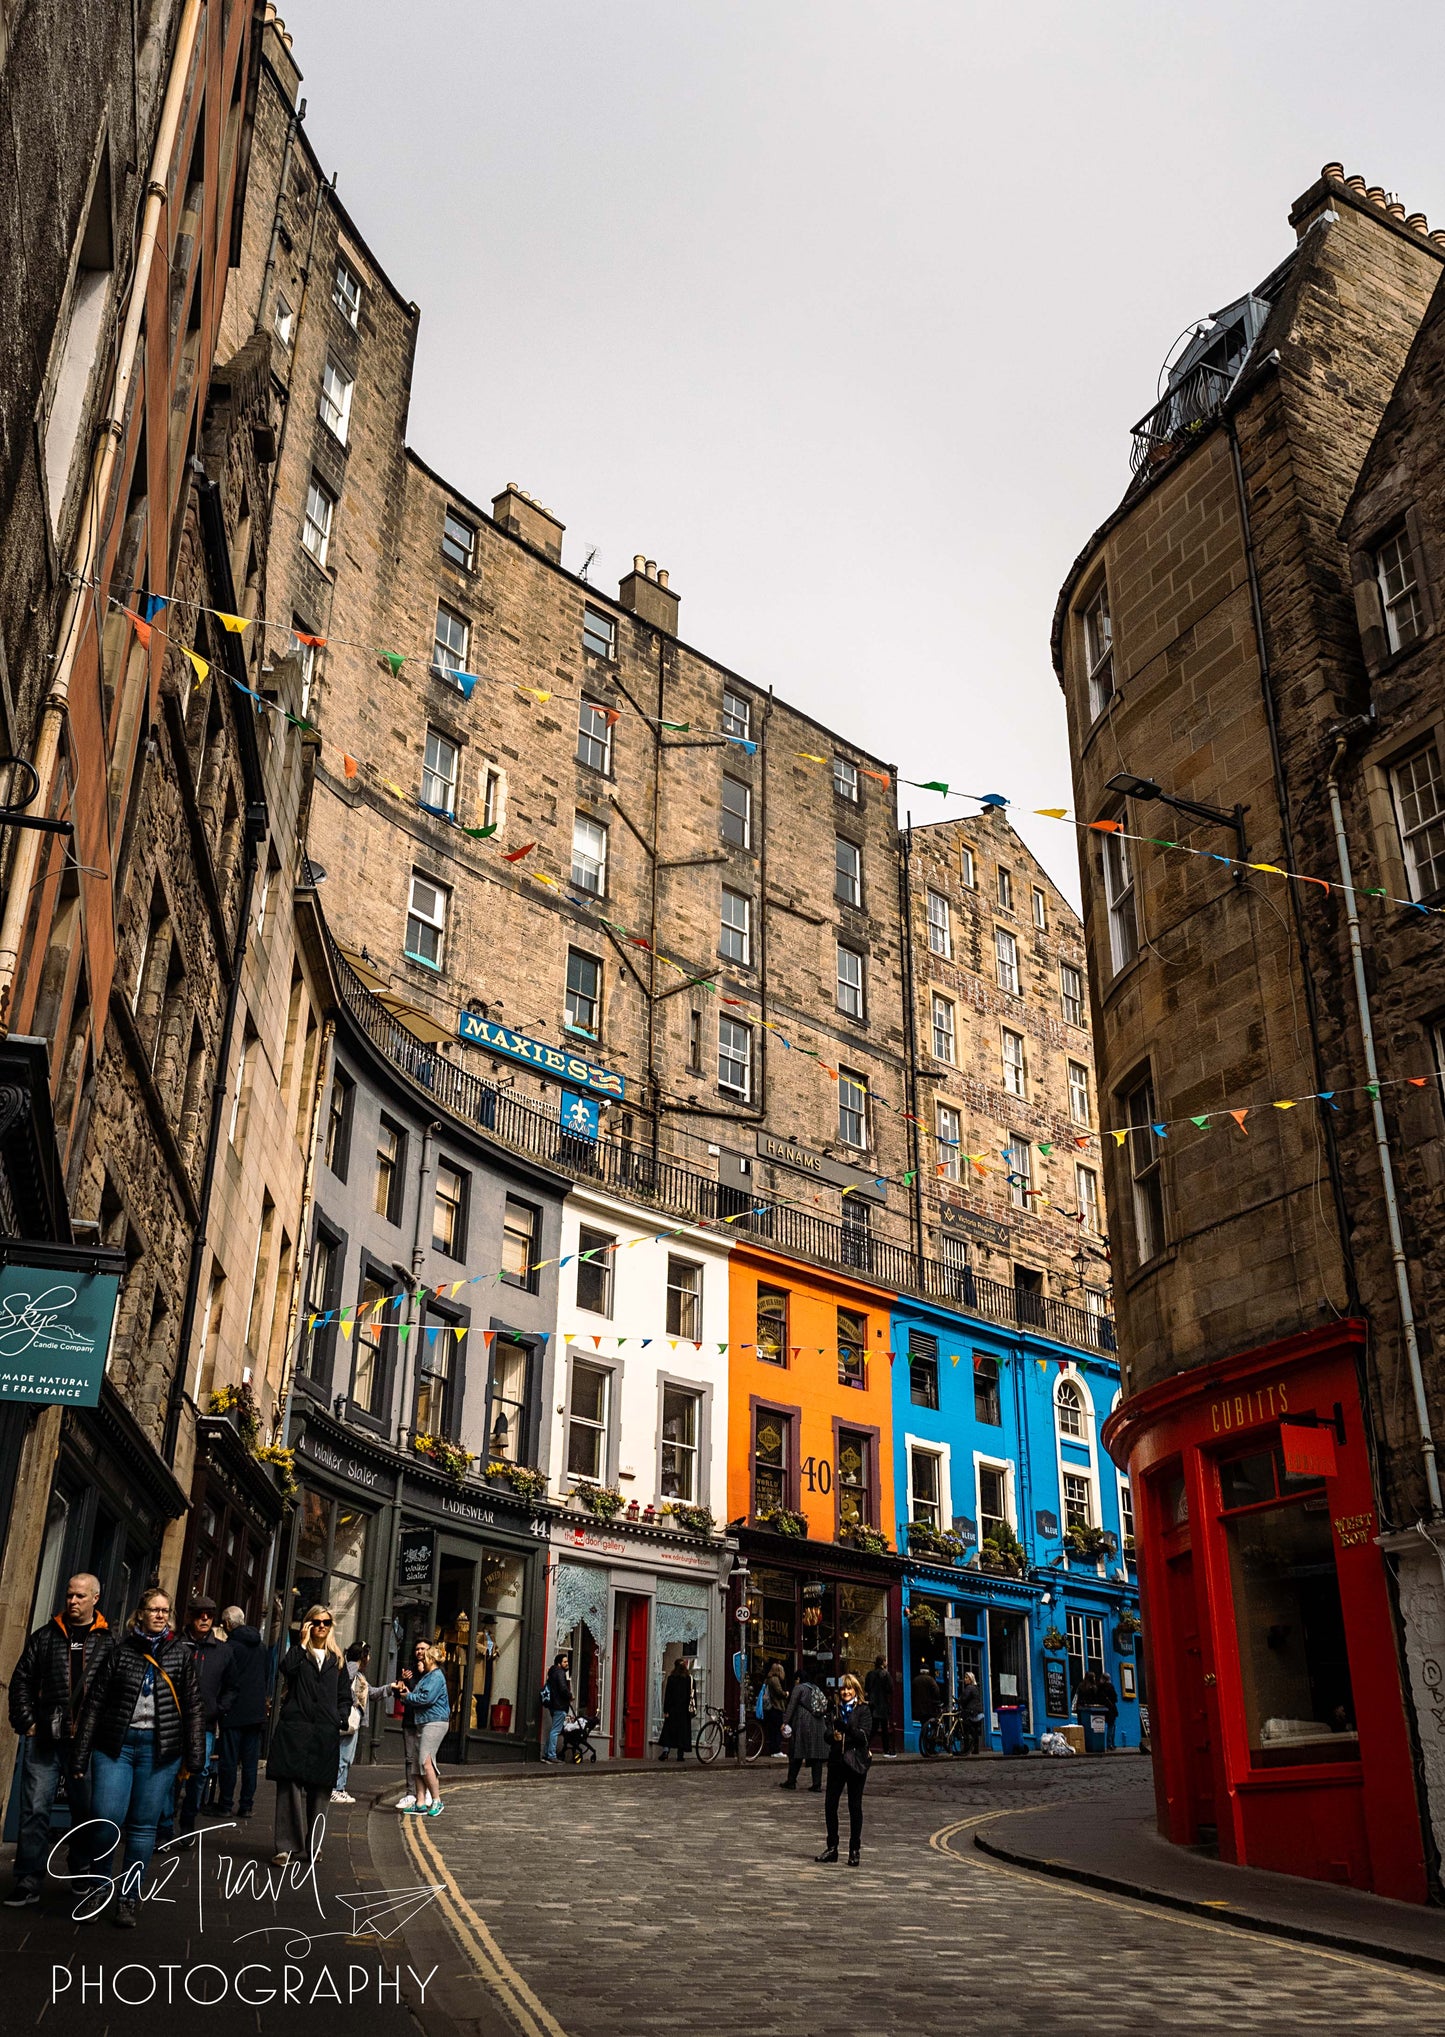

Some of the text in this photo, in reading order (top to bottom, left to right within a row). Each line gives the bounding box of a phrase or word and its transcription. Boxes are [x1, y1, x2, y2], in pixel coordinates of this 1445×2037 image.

[464, 1017, 589, 1080] MAXIES
[766, 1139, 823, 1172] HANAMS
[33, 1341, 94, 1353] Candle Company
[0, 1373, 90, 1388] MADE NATURAL
[13, 1385, 81, 1397] FRAGRANCE
[1211, 1382, 1289, 1433] CUBITTS
[314, 1441, 343, 1470] Walker
[348, 1459, 378, 1487] Slater
[801, 1456, 831, 1494] 40
[442, 1497, 494, 1524] LADIESWEAR
[1334, 1512, 1373, 1534] WEST
[564, 1532, 575, 1542] the
[586, 1536, 600, 1546] door
[602, 1540, 626, 1554] gallery
[1339, 1528, 1370, 1548] BOW
[736, 1608, 750, 1620] 20
